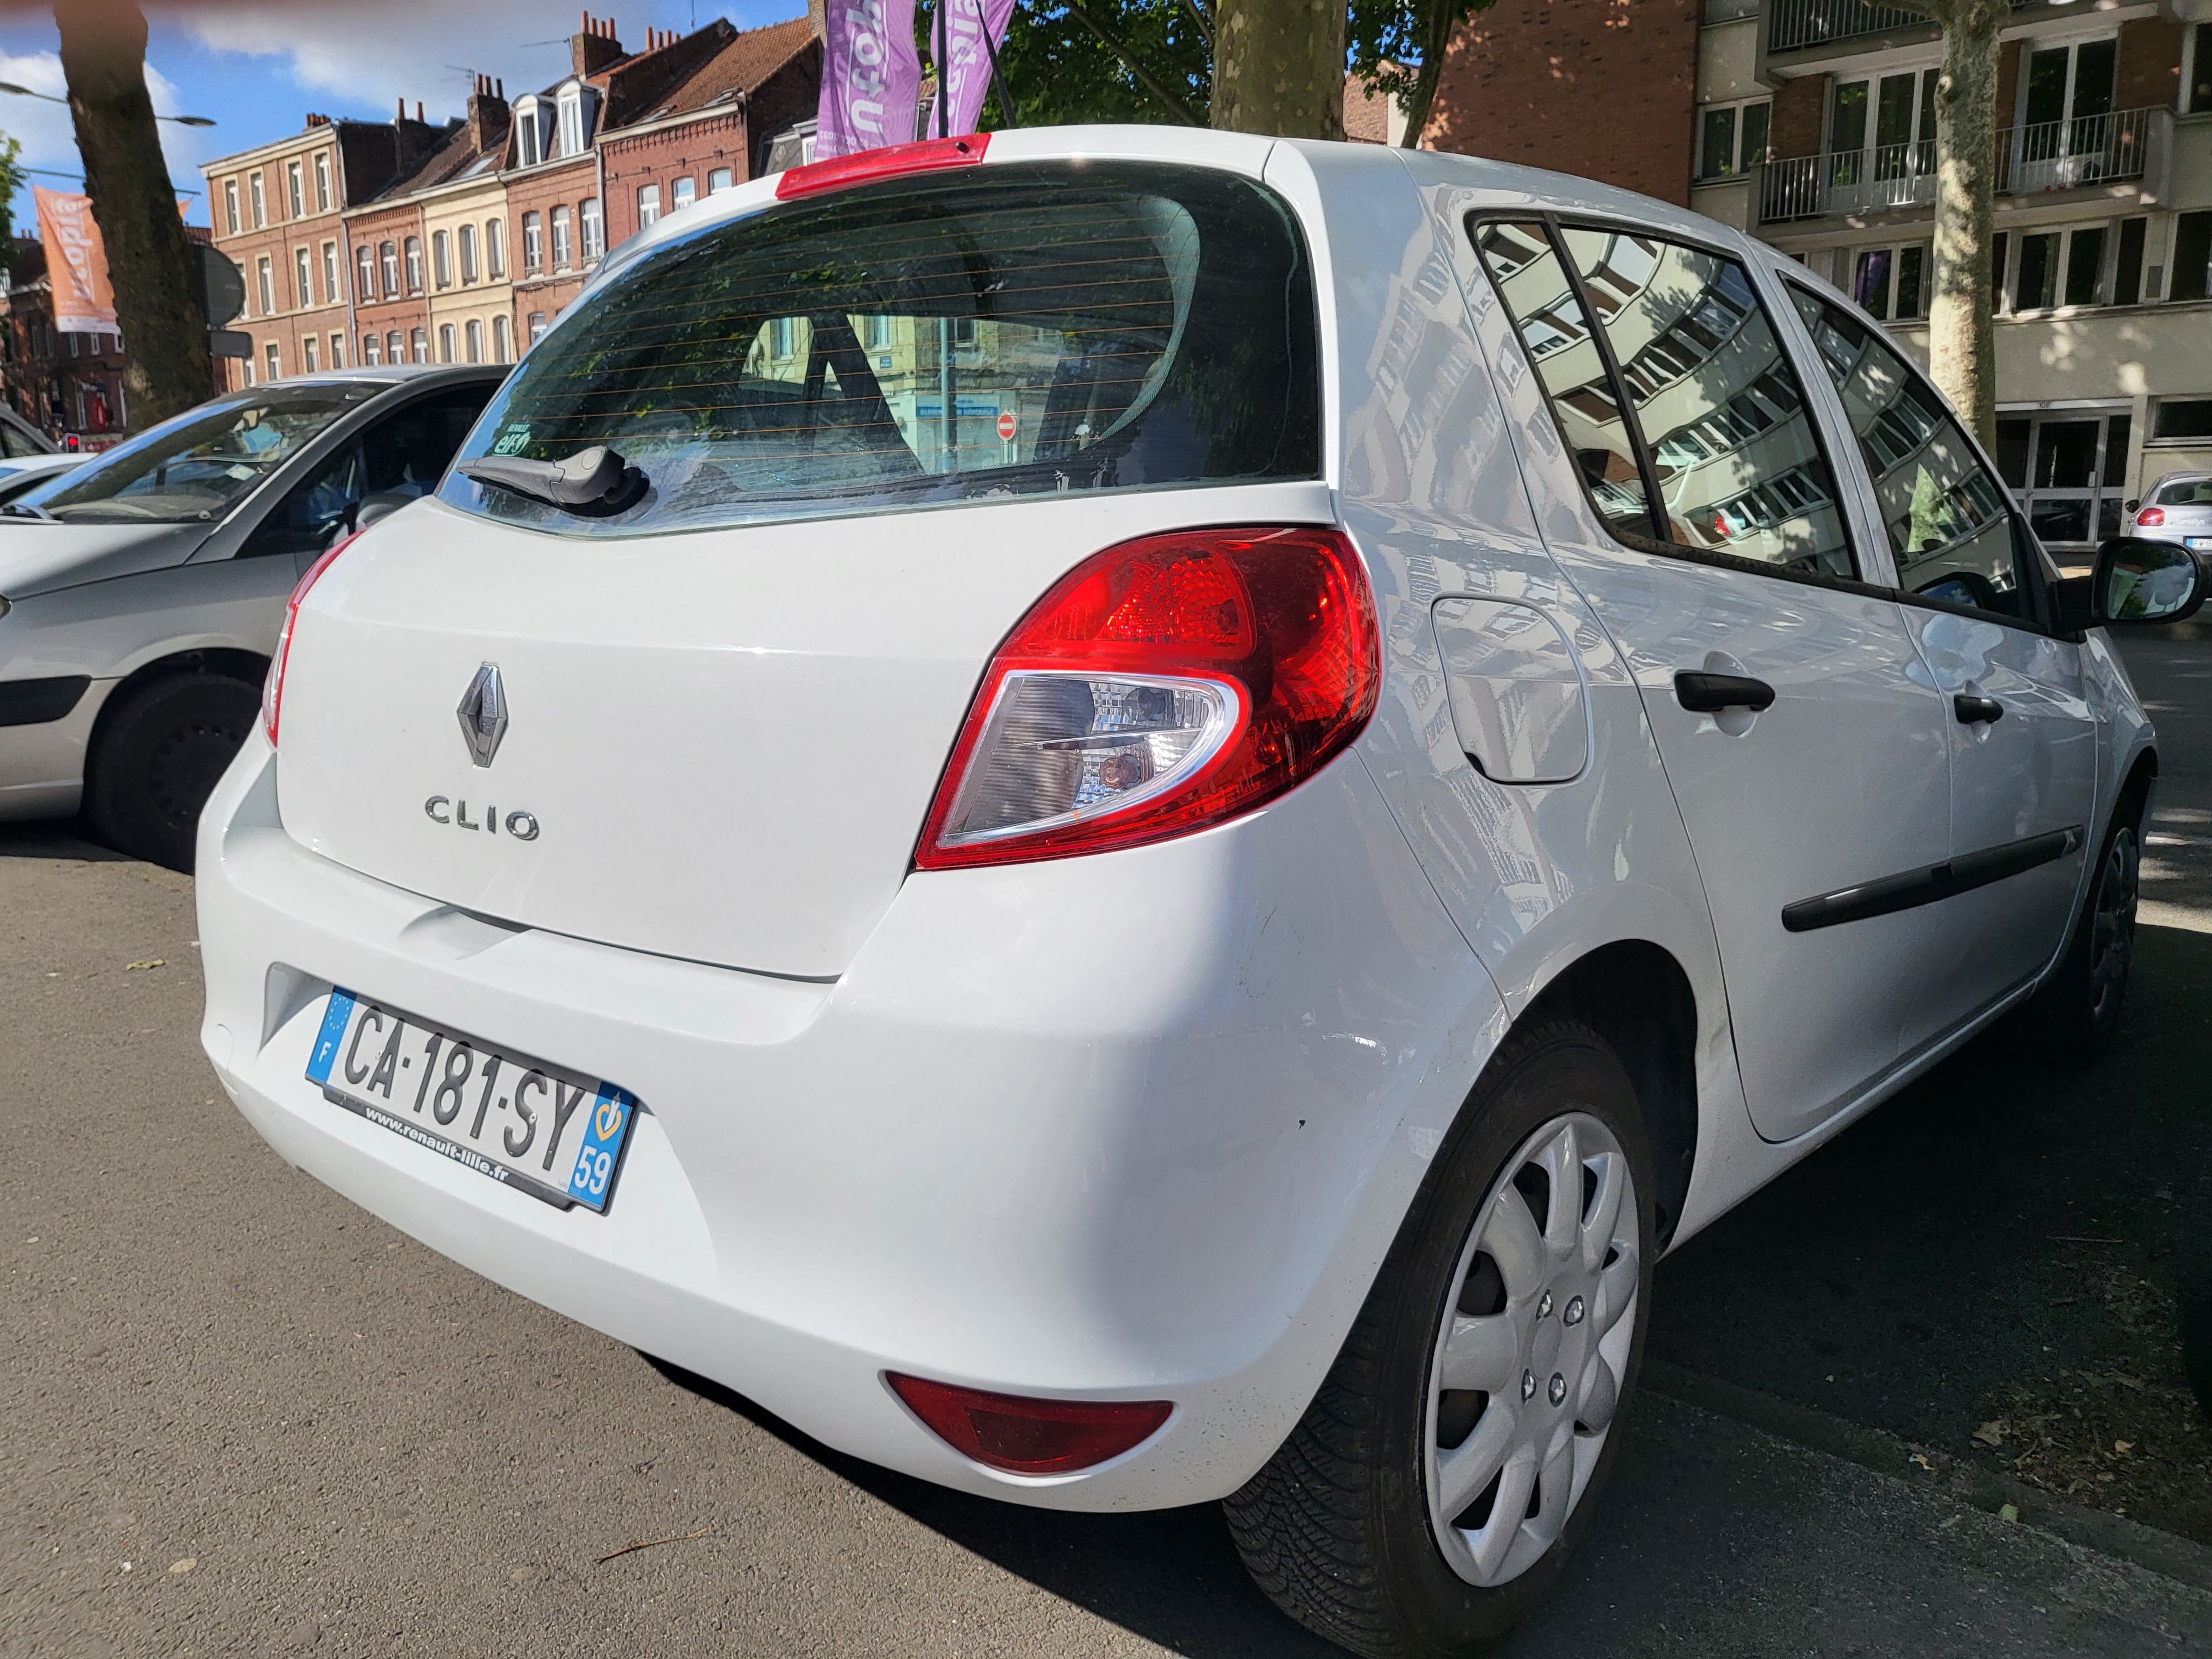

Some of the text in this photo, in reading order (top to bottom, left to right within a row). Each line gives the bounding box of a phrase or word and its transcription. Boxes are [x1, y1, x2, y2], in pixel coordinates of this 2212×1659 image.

[425, 795, 540, 841] CLIO
[319, 1041, 332, 1063] F
[345, 1005, 587, 1171] CA-181-SY
[365, 1106, 510, 1182] www.renault-lille.fr
[575, 1144, 611, 1194] 59
